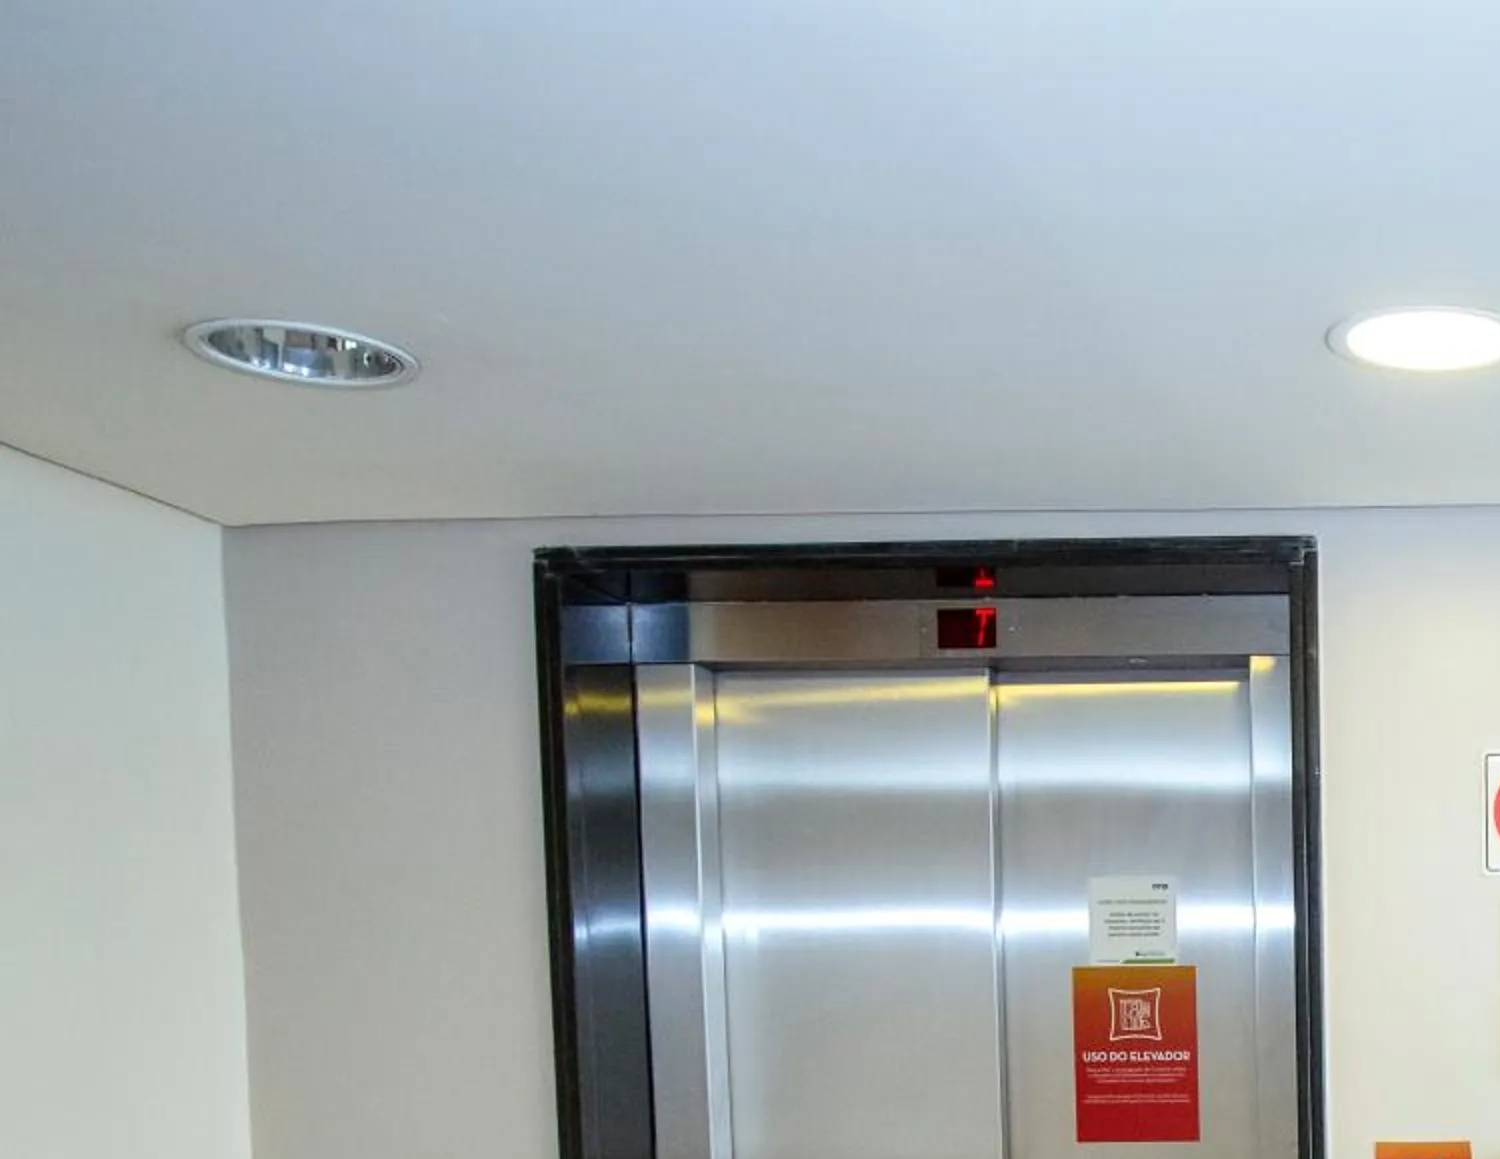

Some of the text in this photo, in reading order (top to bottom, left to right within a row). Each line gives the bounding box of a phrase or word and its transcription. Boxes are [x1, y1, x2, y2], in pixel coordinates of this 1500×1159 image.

[1083, 1051, 1191, 1062] USO DO ELEVADOR
